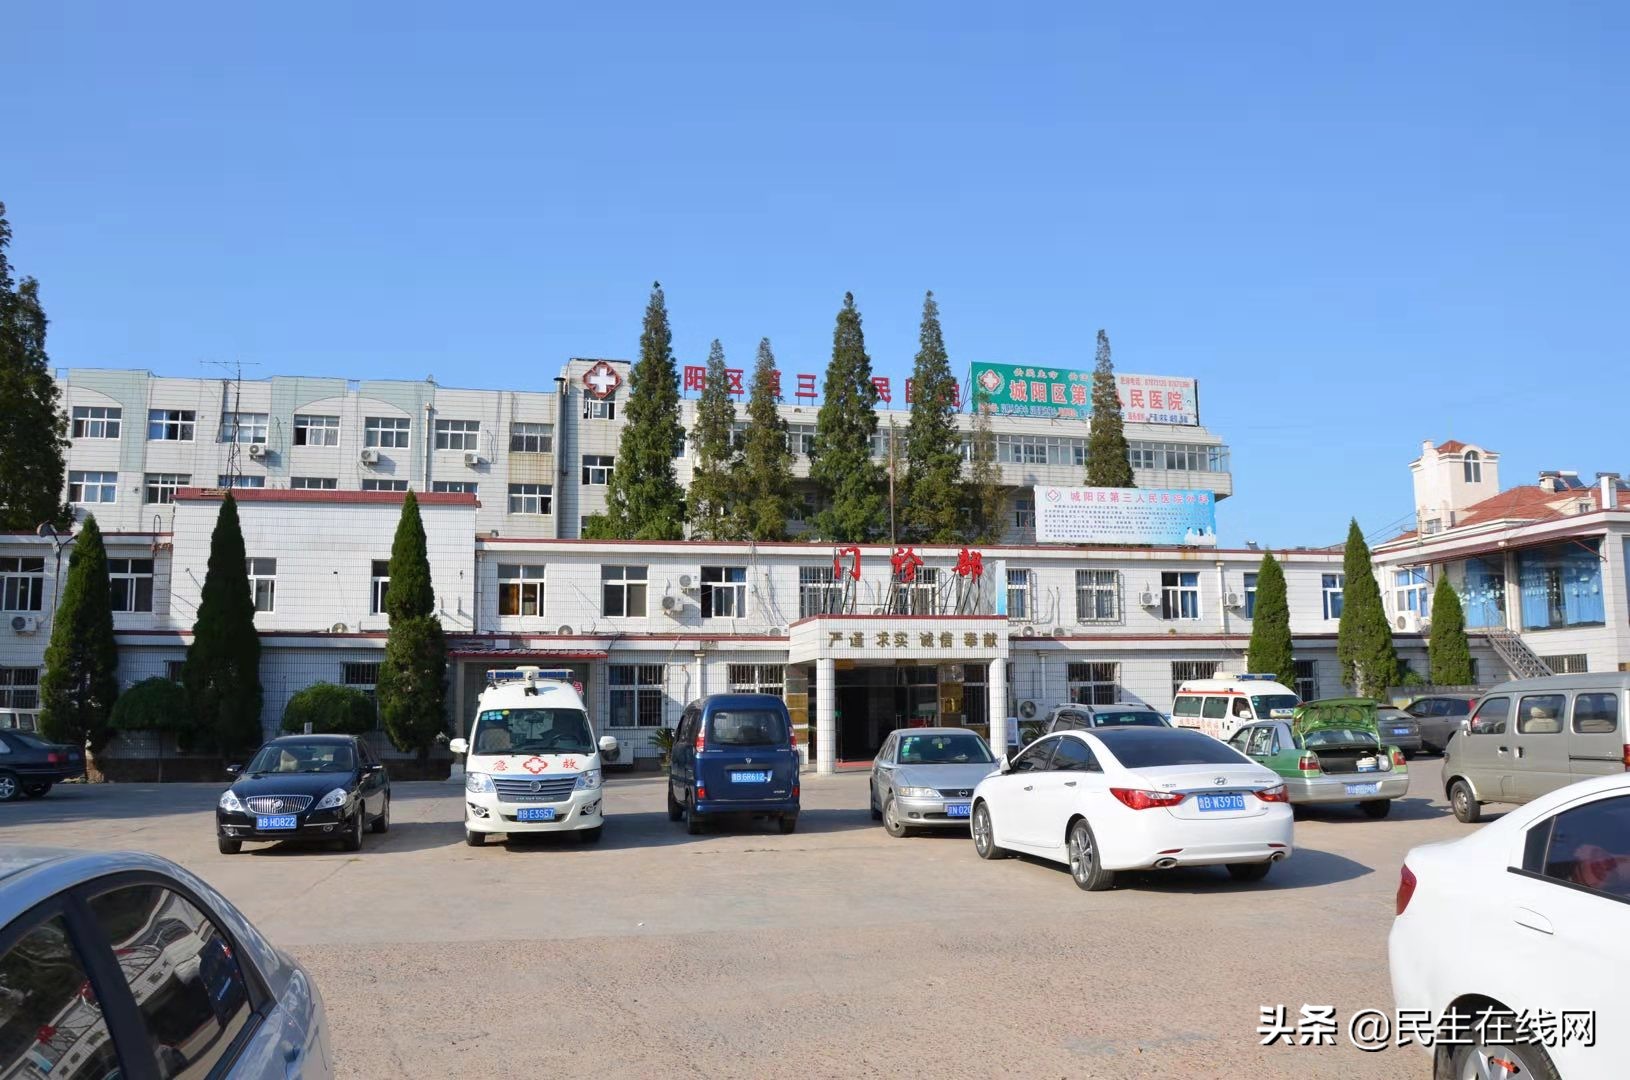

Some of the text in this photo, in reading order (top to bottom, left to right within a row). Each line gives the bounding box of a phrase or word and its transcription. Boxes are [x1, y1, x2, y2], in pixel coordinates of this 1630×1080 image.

[1009, 379, 1183, 411] 城阳区第民医院
